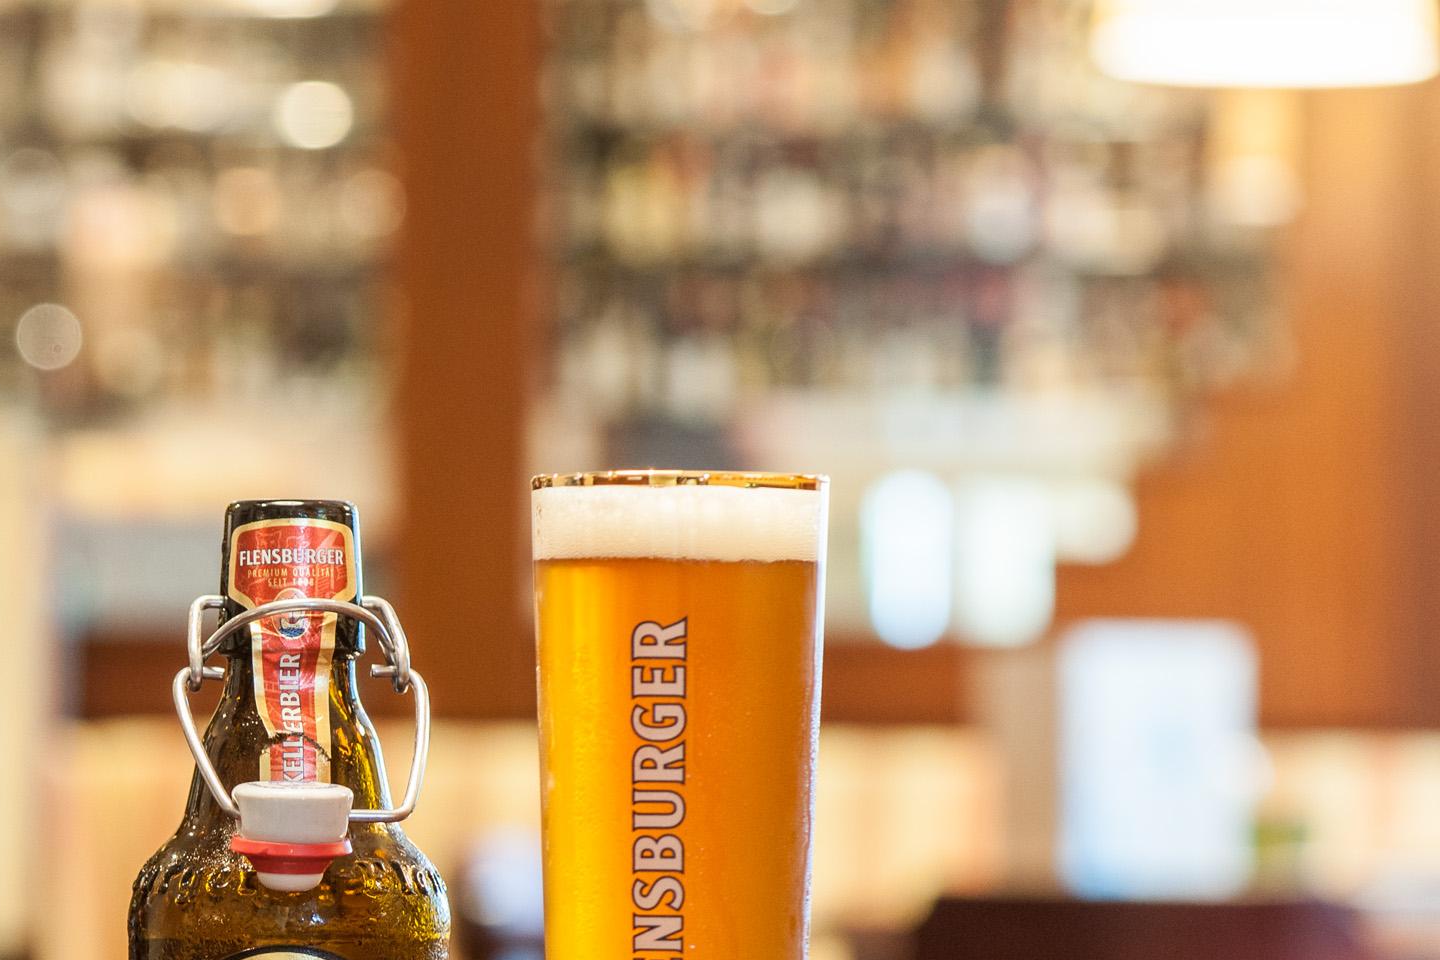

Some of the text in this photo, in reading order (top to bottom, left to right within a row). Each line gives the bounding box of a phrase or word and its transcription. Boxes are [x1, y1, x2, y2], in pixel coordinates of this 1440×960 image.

[239, 547, 344, 567] FLENSBURGER
[247, 567, 288, 579] PREMIUM
[279, 652, 305, 783] KELLERBIER
